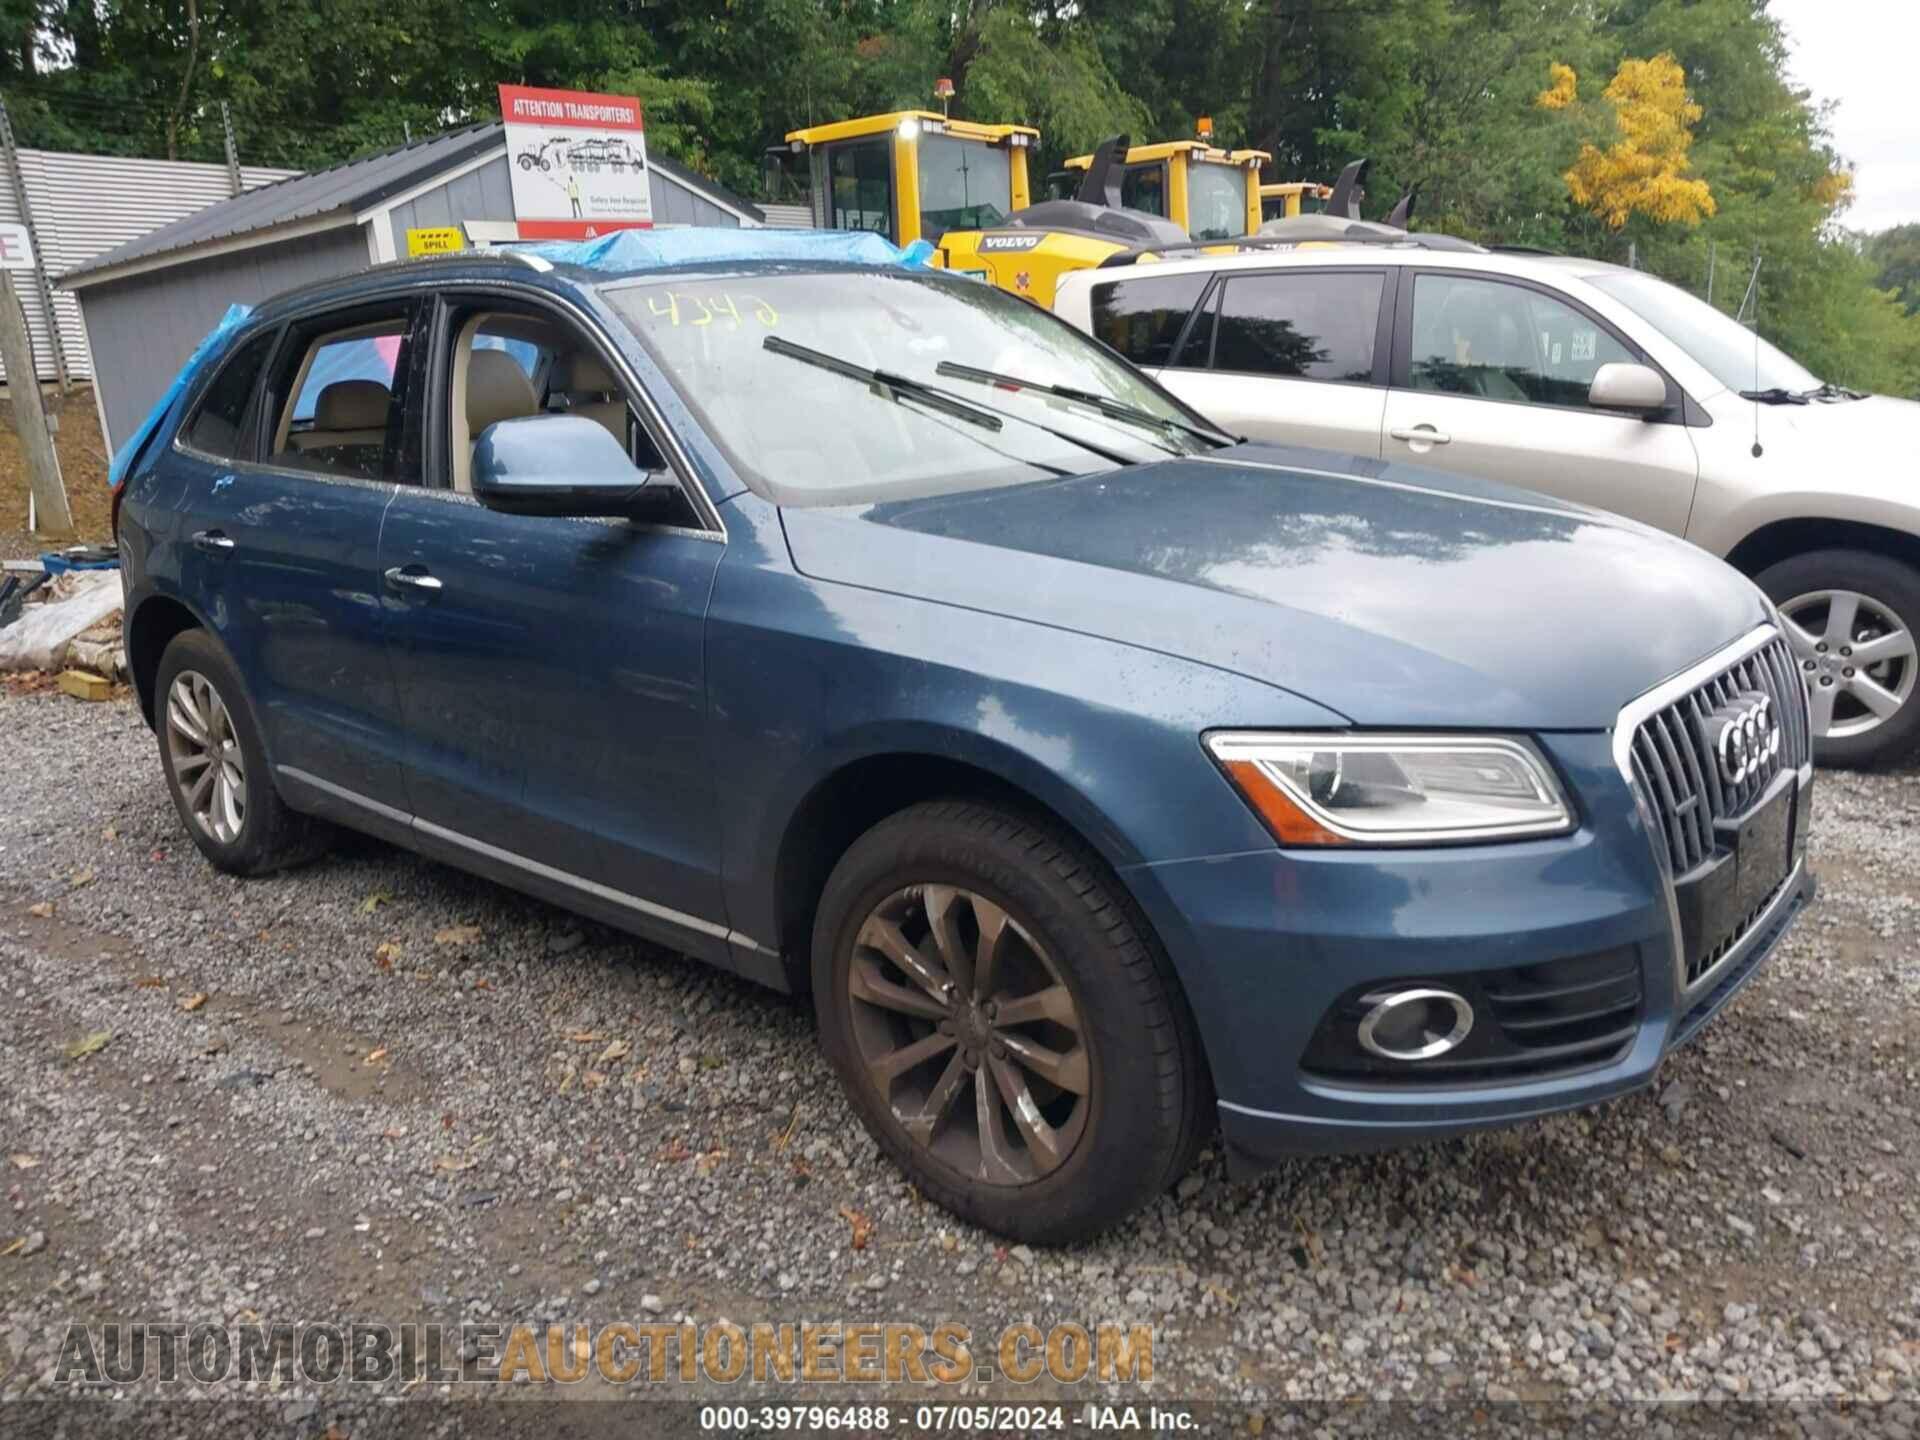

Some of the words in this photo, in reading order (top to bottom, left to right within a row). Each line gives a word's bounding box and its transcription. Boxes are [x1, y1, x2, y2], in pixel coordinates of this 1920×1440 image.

[513, 98, 563, 119] ATTENTION
[564, 103, 635, 123] TRANSPORTERS!
[424, 240, 448, 249] SPILL
[986, 237, 1037, 248] VOLVO
